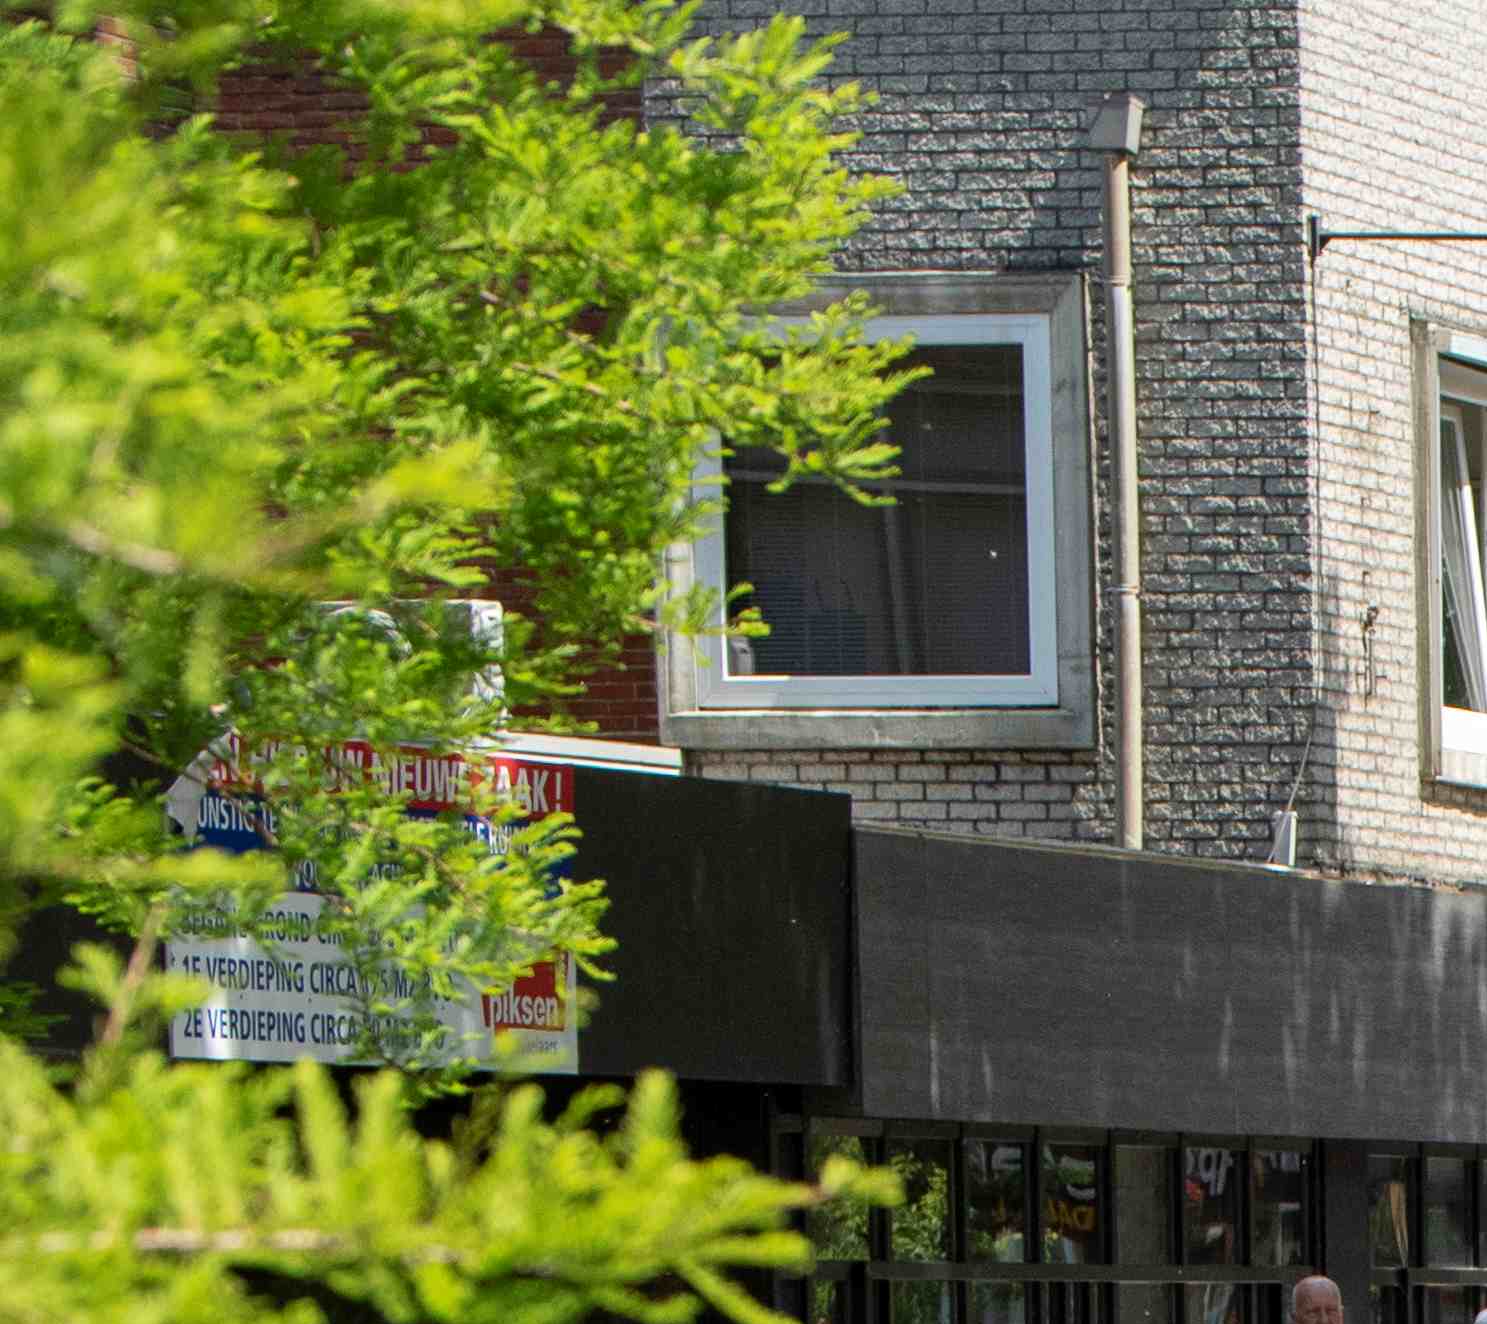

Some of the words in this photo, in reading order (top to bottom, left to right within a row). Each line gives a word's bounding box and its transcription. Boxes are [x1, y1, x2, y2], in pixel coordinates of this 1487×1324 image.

[198, 797, 256, 833] UNSTIG
[207, 957, 304, 992] VERDIEPING
[310, 963, 357, 998] CIRCA
[184, 1009, 203, 1039] 2E
[208, 1009, 305, 1044] VERDIEPING
